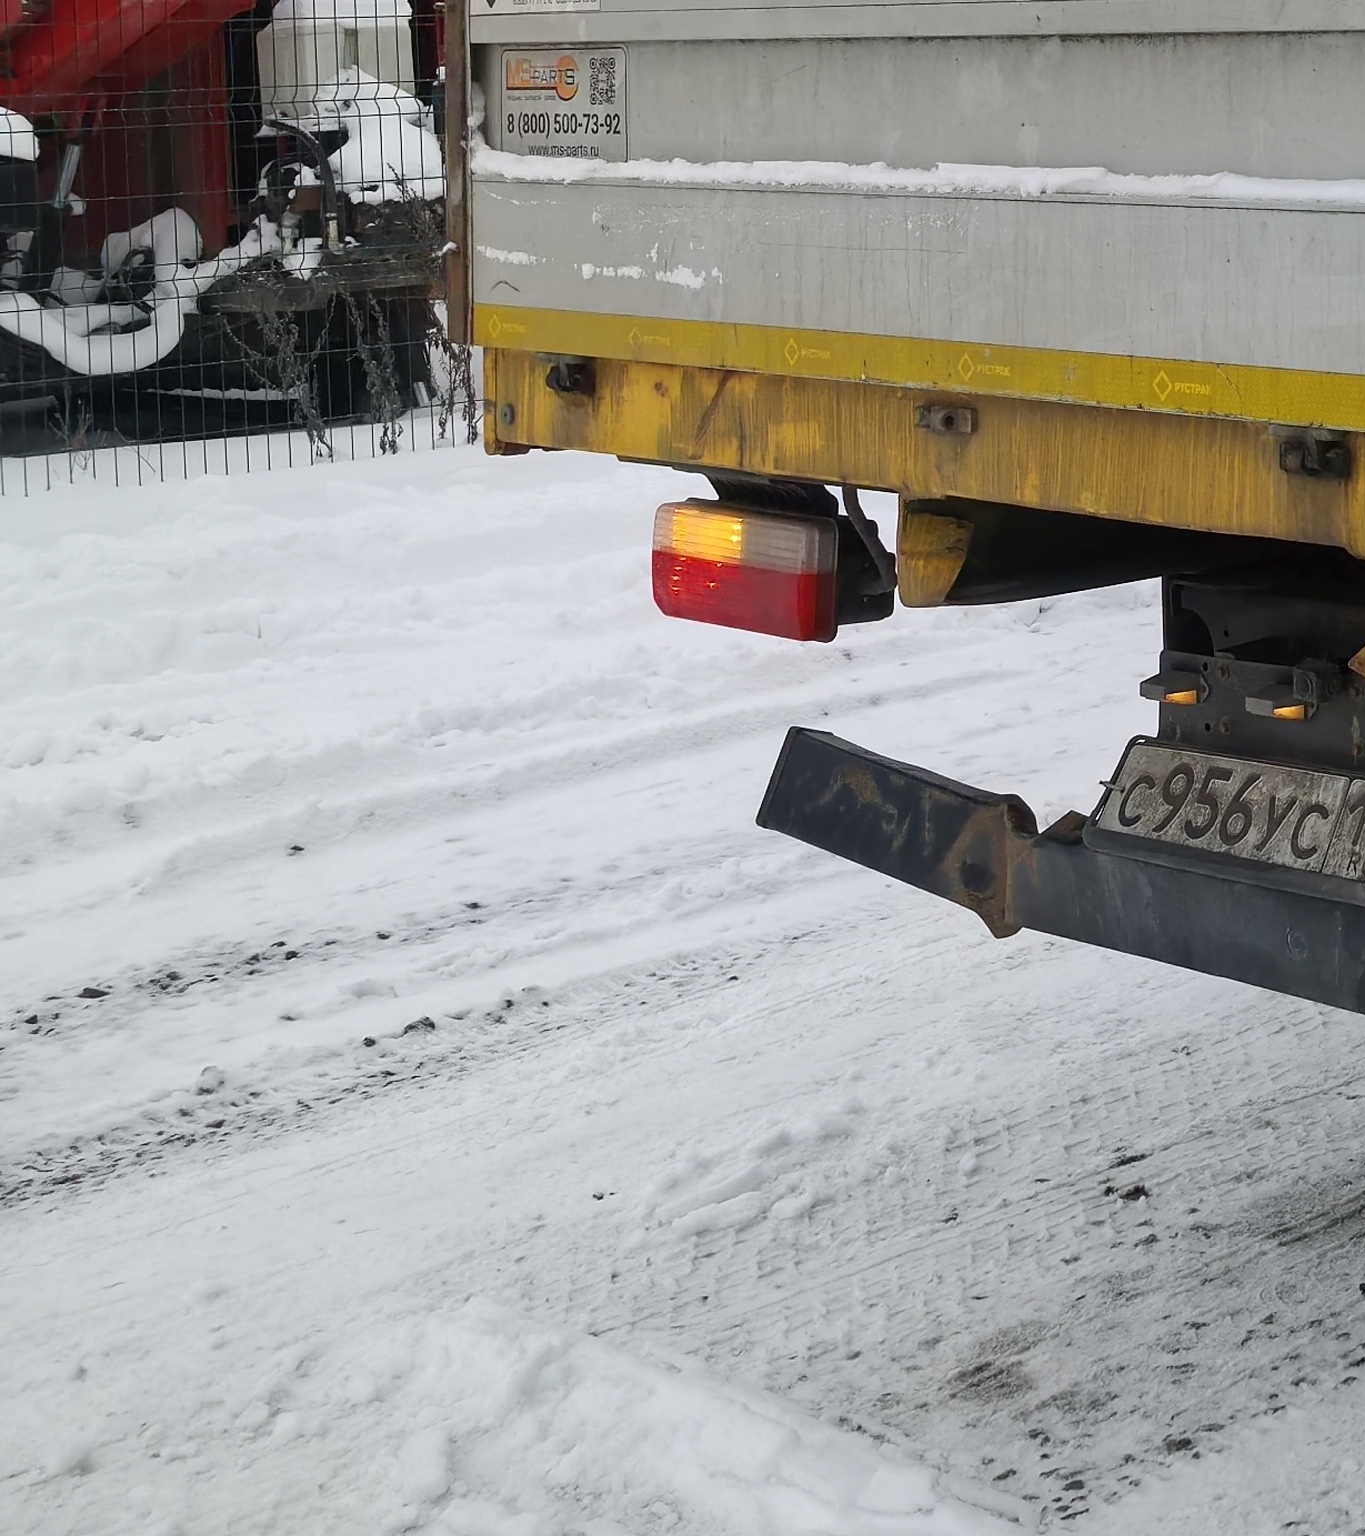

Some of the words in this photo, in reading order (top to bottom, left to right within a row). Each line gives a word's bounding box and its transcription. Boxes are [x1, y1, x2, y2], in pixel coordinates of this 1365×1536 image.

[507, 112, 515, 134] 8
[518, 112, 550, 140] (800)
[553, 112, 622, 136] 500-73-92
[528, 144, 600, 158] www.ms-parts.ru
[1173, 381, 1212, 396] РУСТРАК
[1117, 762, 1330, 861] С956УС
